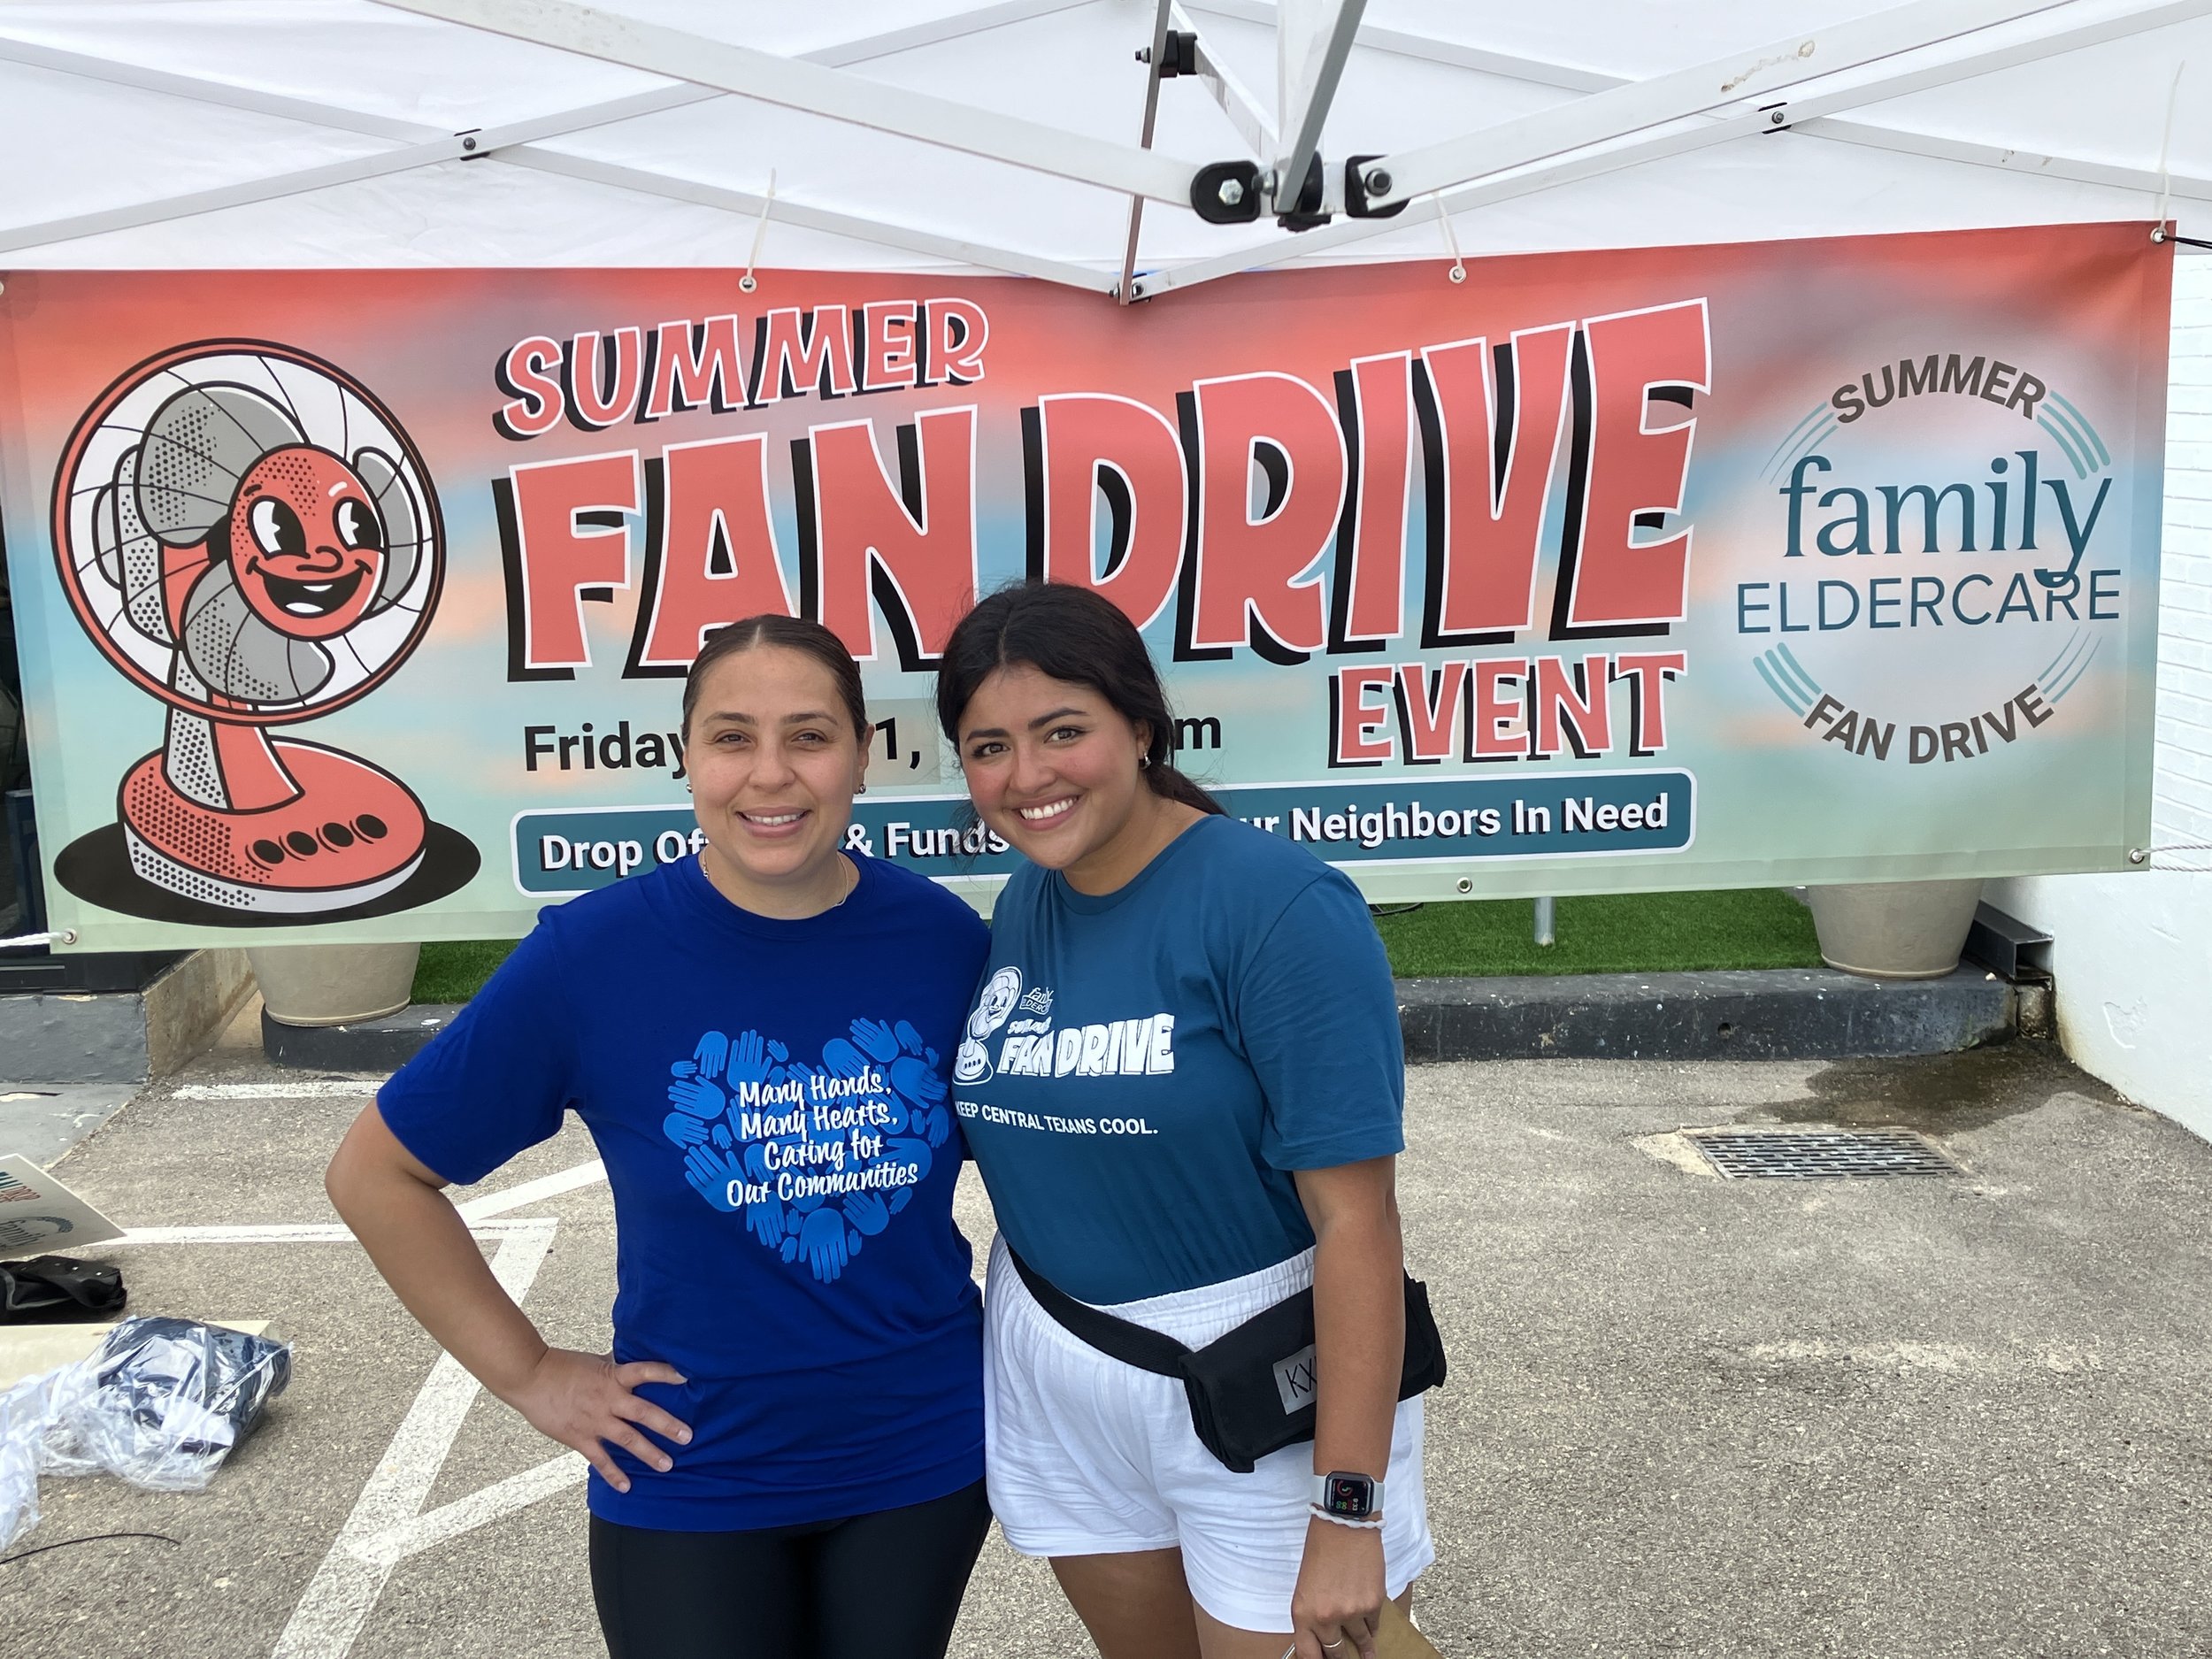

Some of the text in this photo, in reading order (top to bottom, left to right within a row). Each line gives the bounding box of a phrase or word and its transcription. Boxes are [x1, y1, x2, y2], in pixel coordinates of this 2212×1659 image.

[493, 297, 990, 442] SUMMER
[1831, 354, 2047, 423] SUMMER
[492, 297, 1711, 682] FAN DRIVE
[1778, 450, 2113, 588] family
[1737, 568, 2122, 634] ELDERCARE
[1328, 650, 1687, 768] EVENT
[1803, 683, 2055, 764] FAN DRIVE
[541, 833, 643, 876] Drop
[845, 823, 875, 857] &
[886, 818, 1010, 859] Funds
[1291, 801, 1502, 848] Neighbors
[1513, 798, 1551, 834] In
[1563, 792, 1669, 833] Need
[995, 1012, 1175, 1079] FAN DRIVE
[739, 1064, 893, 1110] Many Hands,
[741, 1099, 899, 1141] Many Hearts,
[981, 1104, 1045, 1132] CENTRAL
[1043, 1115, 1097, 1135] TEXANS
[1099, 1118, 1159, 1135] COOL.
[764, 1127, 885, 1171] Caring for
[726, 1162, 919, 1207] Our Communities
